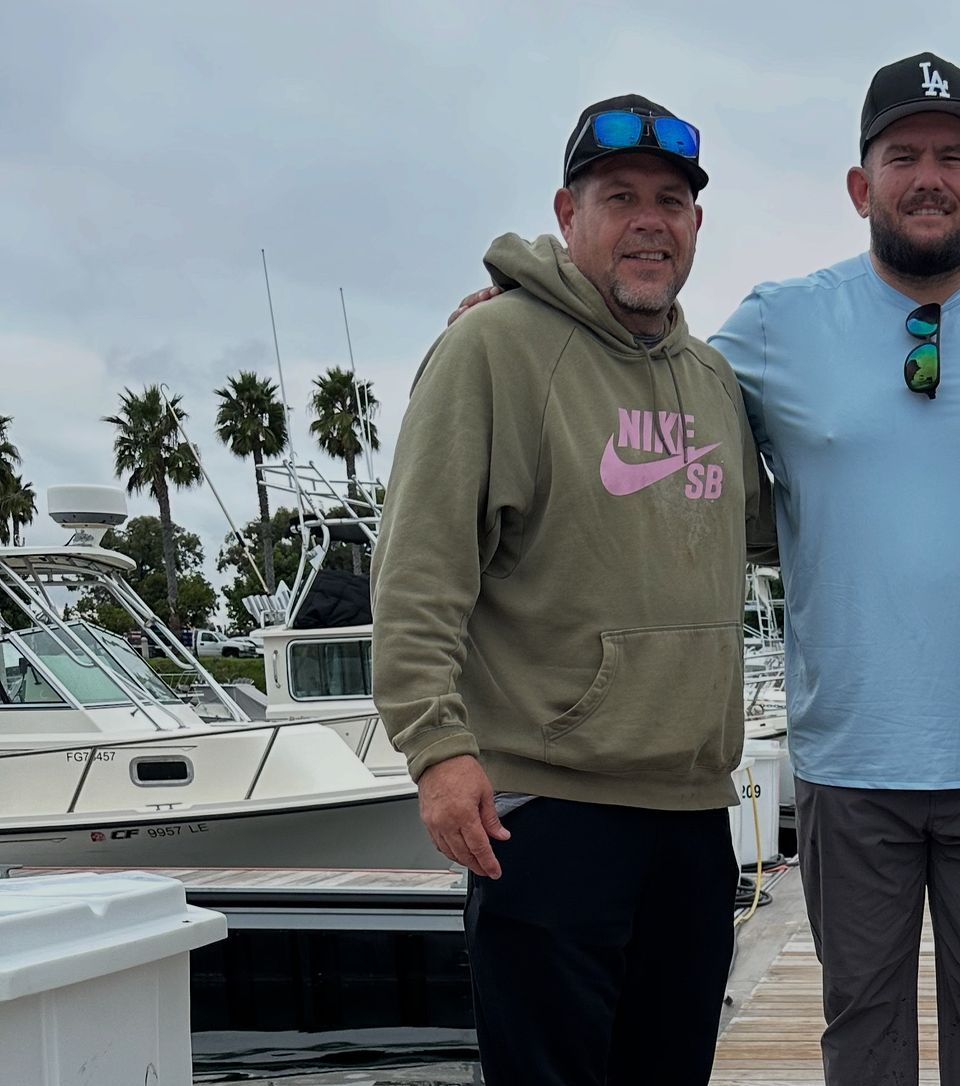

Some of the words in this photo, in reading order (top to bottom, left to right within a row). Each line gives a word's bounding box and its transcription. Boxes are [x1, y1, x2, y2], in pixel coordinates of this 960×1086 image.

[919, 61, 950, 98] LA
[617, 408, 695, 455] NIKE
[685, 463, 724, 499] SB
[66, 751, 115, 762] FG7457
[111, 829, 140, 840] CF
[147, 825, 182, 838] 9957
[188, 822, 209, 834] LE
